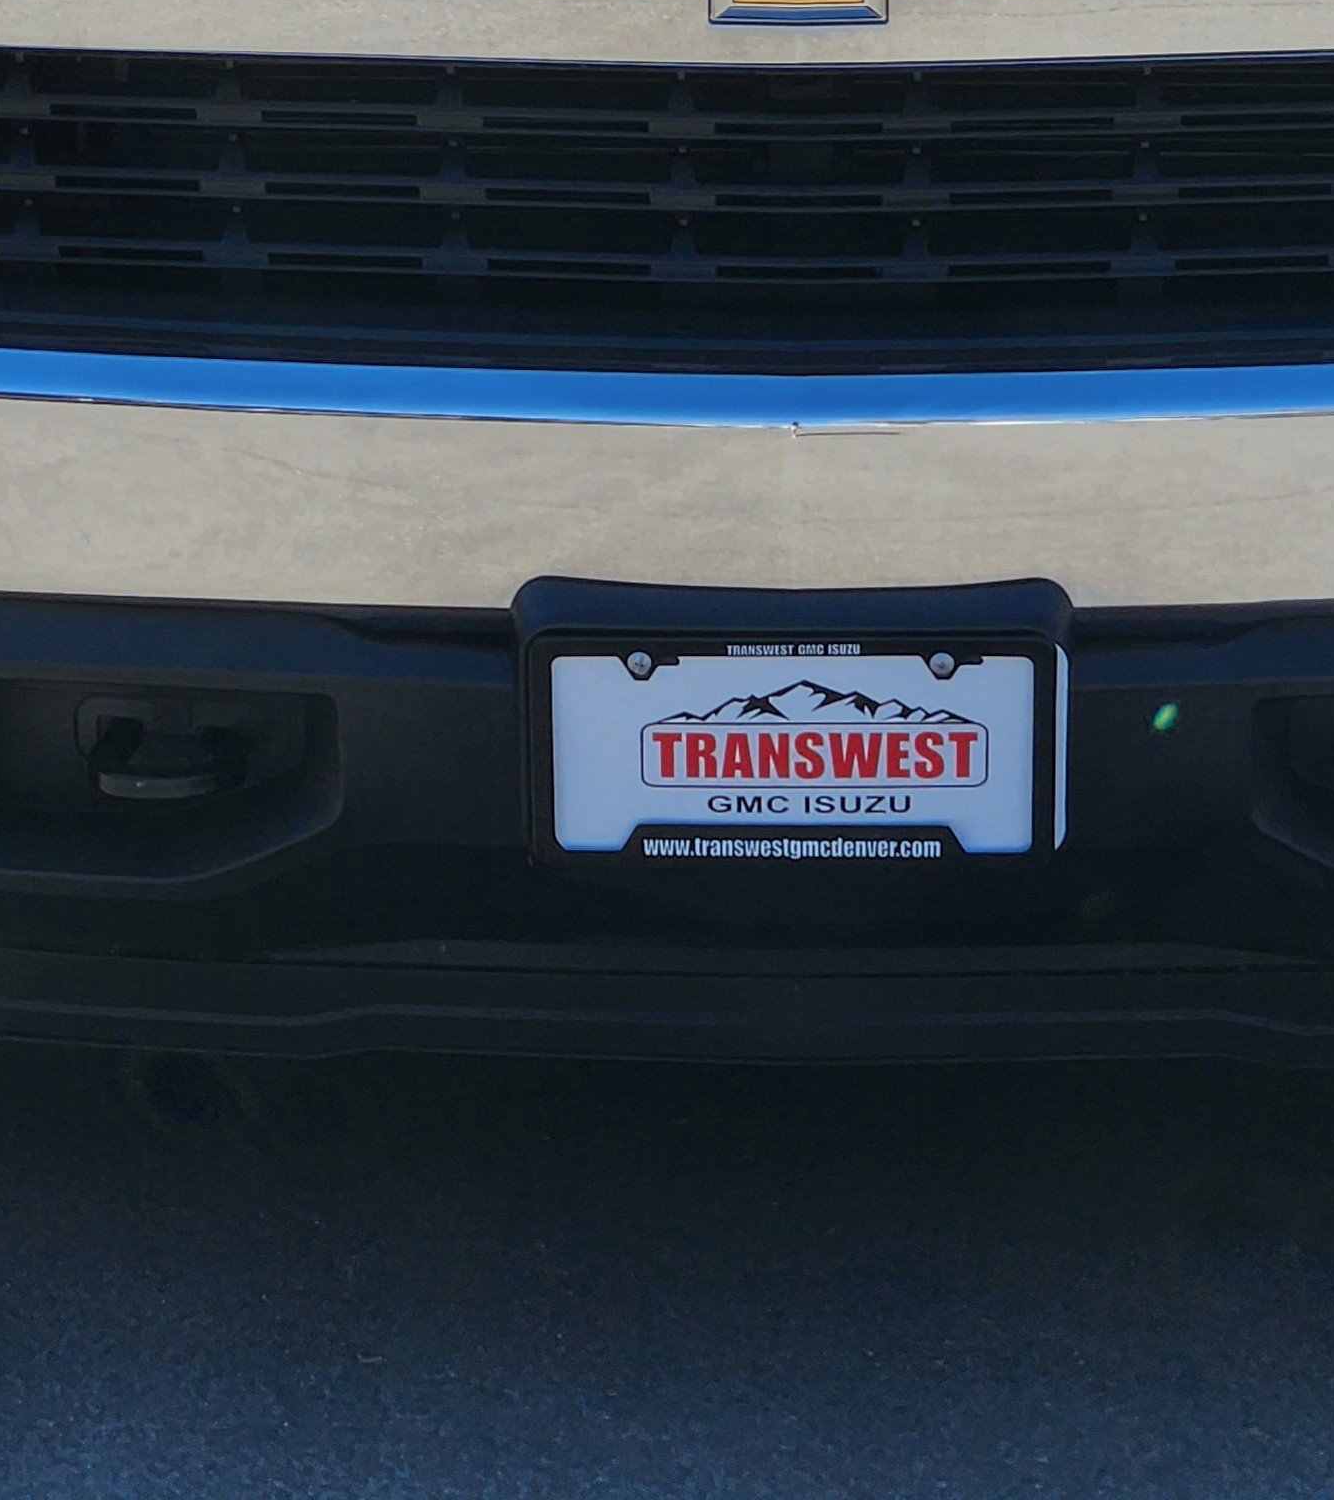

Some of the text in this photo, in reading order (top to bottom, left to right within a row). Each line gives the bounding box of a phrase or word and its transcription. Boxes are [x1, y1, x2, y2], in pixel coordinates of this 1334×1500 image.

[727, 643, 861, 656] TRANSWEST GMC ISUZU
[651, 731, 979, 780] TRANSWEST
[707, 795, 911, 814] GMC ISUZU
[643, 836, 941, 860] www.transwestgmcdenver.com
